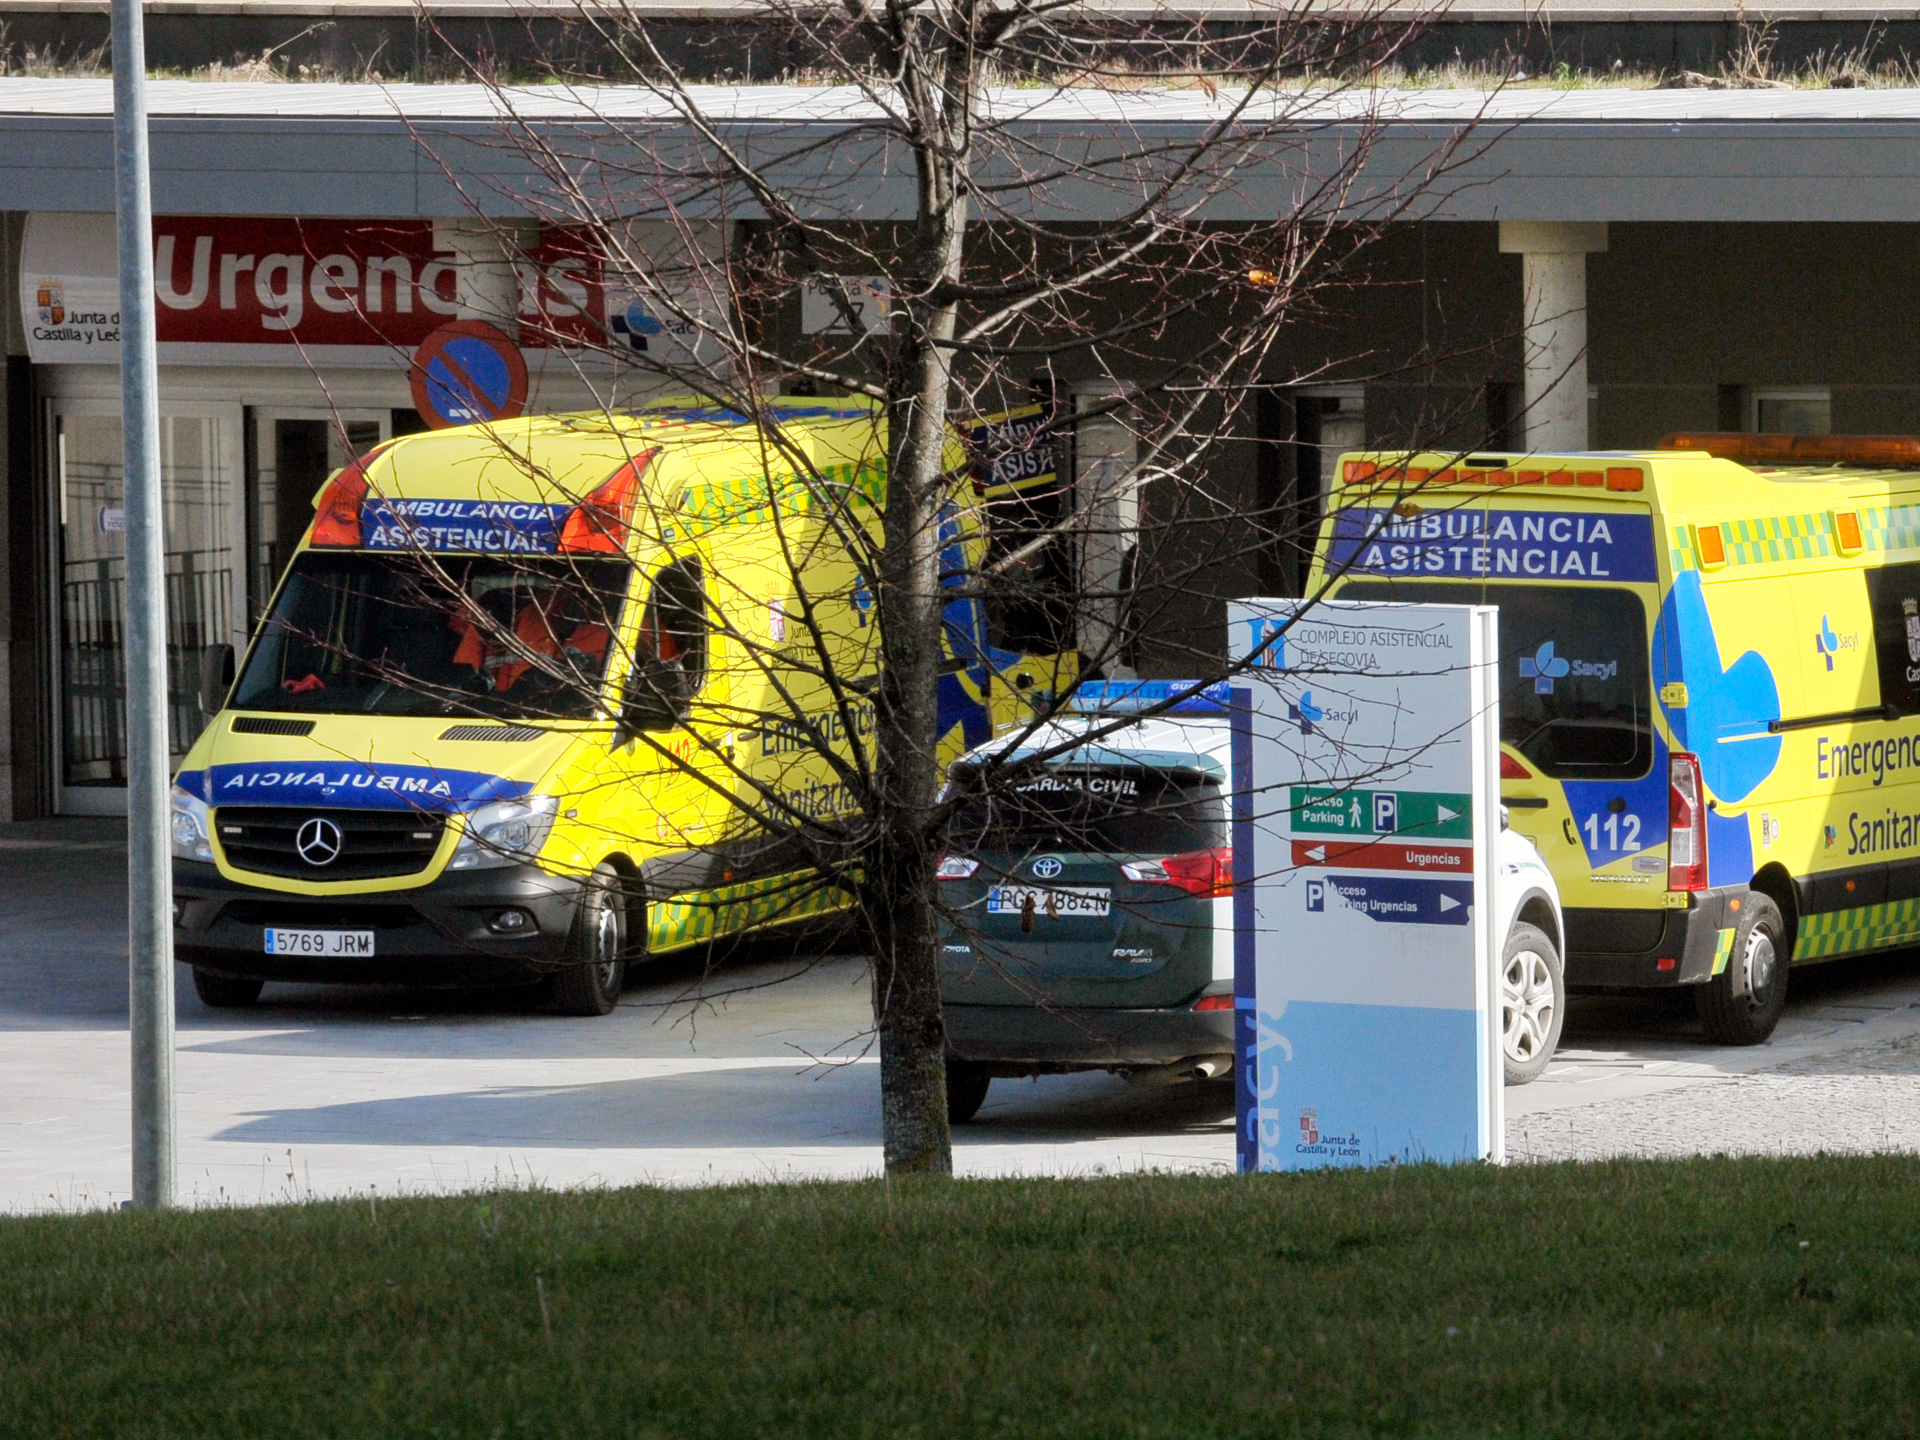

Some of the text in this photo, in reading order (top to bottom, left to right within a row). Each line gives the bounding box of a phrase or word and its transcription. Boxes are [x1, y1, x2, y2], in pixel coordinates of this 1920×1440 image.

[69, 311, 107, 324] Junta
[33, 327, 82, 340] Castilla
[84, 331, 93, 344] y
[374, 501, 554, 521] AMBULANCIA
[1364, 512, 1613, 545] AMBULANCIA
[369, 525, 547, 552] ASISTENCIAL
[1364, 545, 1610, 577] ASISTENCIAL
[1300, 629, 1453, 649] COMPLEJO ASISTENCIAL
[1838, 631, 1859, 653] Sacyl
[1301, 652, 1378, 668] DE SEGOVIA
[1571, 659, 1617, 680] Sacyl
[1326, 708, 1358, 725] Sacyl
[1089, 778, 1138, 795] CIVIL
[1303, 795, 1344, 807] Acceso
[1302, 810, 1345, 826] Parking
[1377, 799, 1394, 826] P
[1583, 813, 1642, 851] 112
[1405, 851, 1461, 867] Urgencias
[1308, 884, 1323, 909] P
[1369, 900, 1418, 914] Urgencias
[276, 933, 370, 954] 5769 JRM
[1320, 1133, 1360, 1146] Junta de
[1295, 1143, 1360, 1158] Castilla y León
